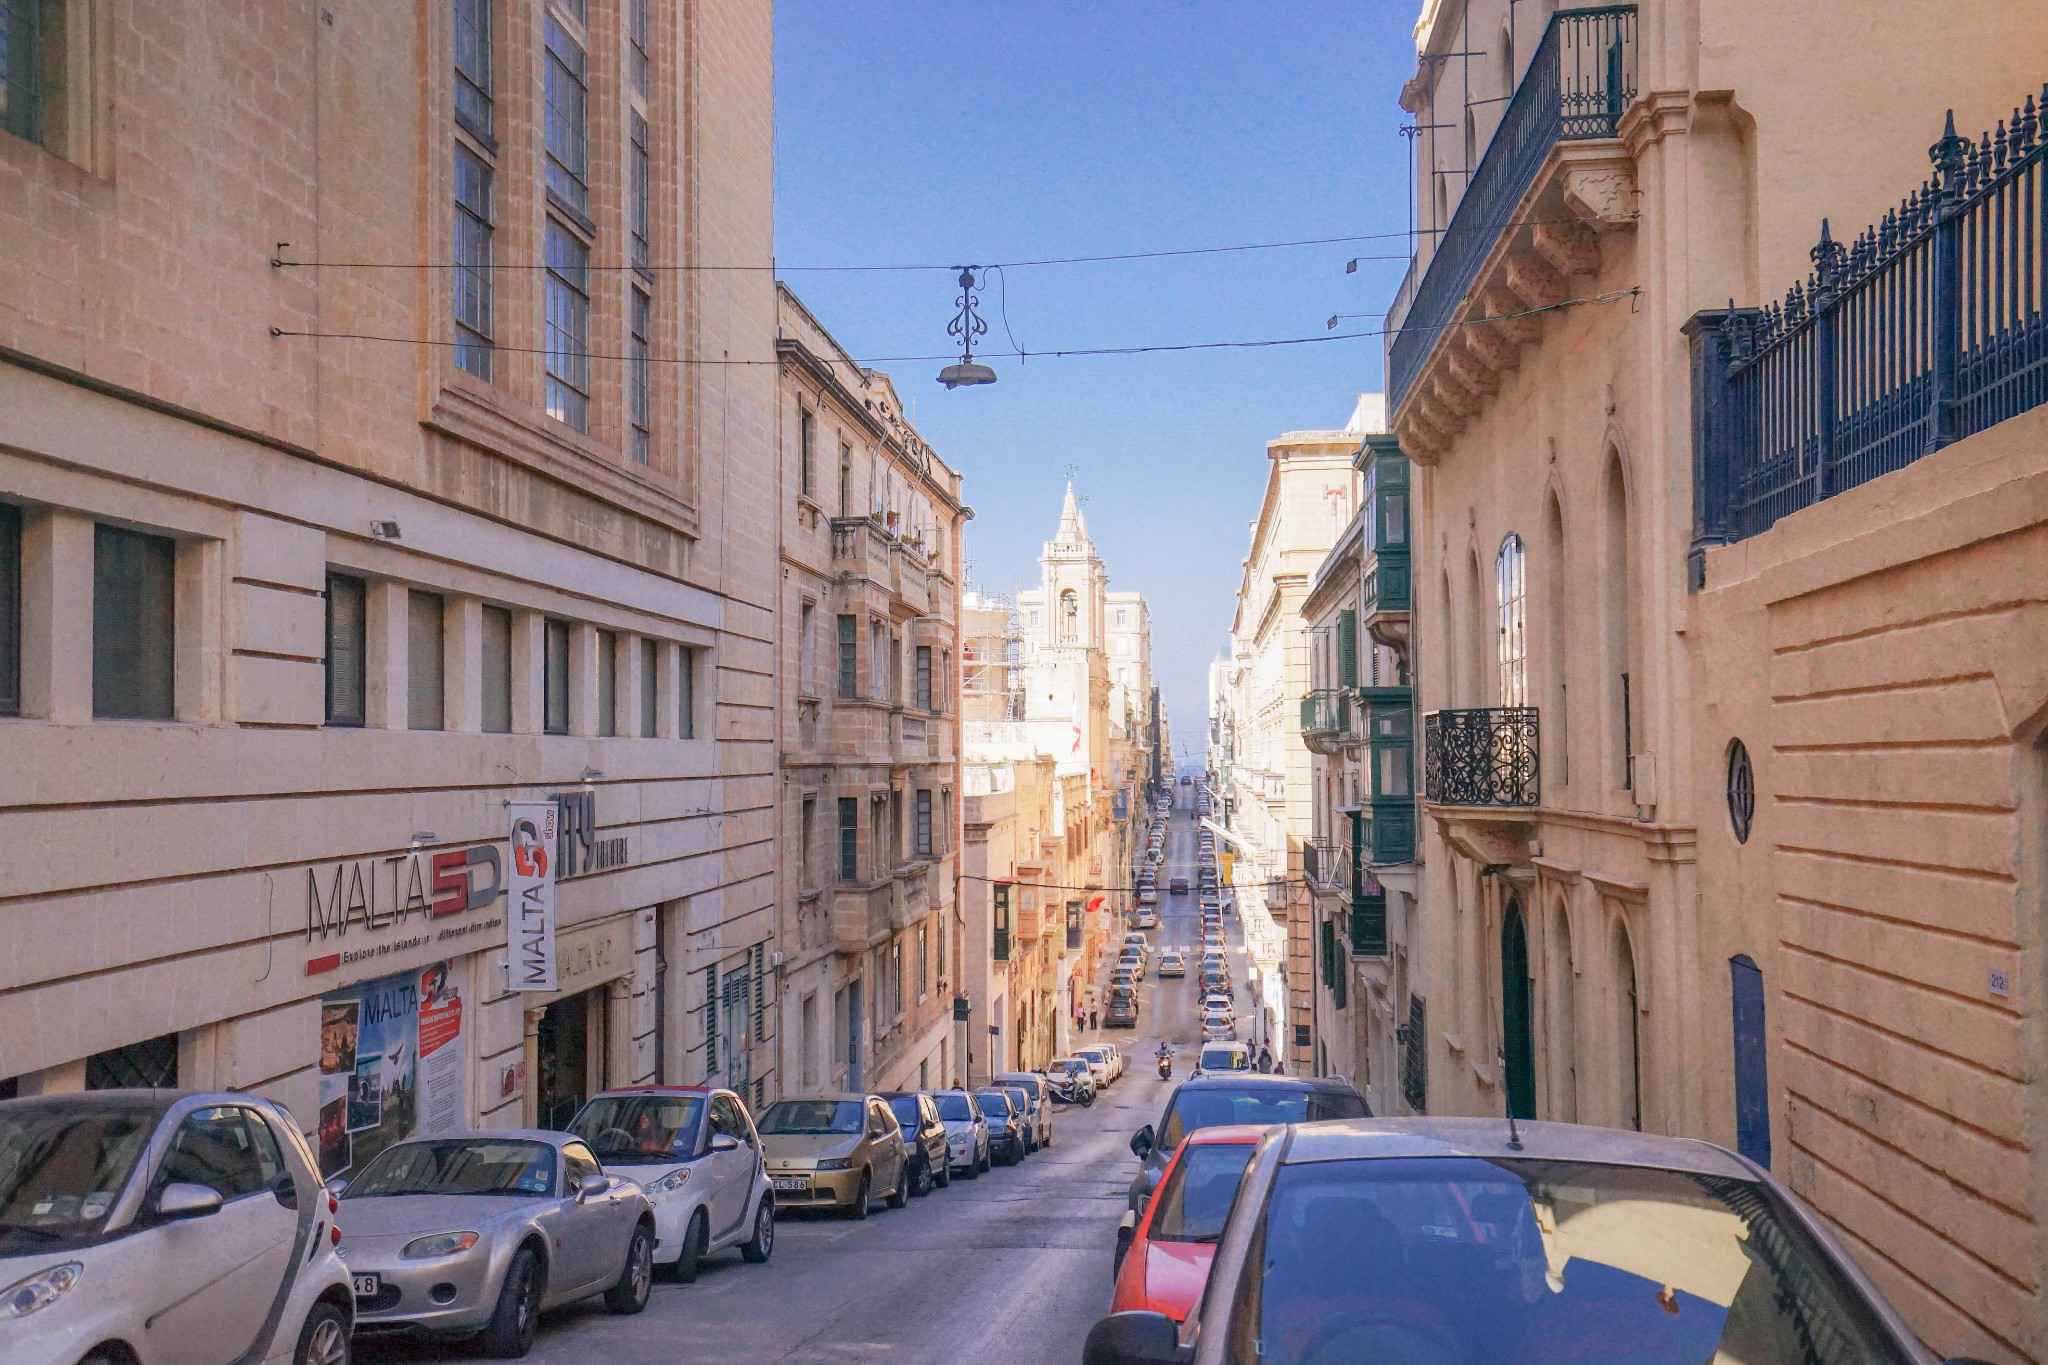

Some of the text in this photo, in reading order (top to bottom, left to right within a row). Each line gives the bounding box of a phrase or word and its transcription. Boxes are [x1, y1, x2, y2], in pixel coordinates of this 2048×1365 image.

[307, 844, 502, 944] MALTA 5D
[521, 883, 546, 984] MALTA
[544, 809, 554, 840] show
[364, 984, 418, 1027] MALTA
